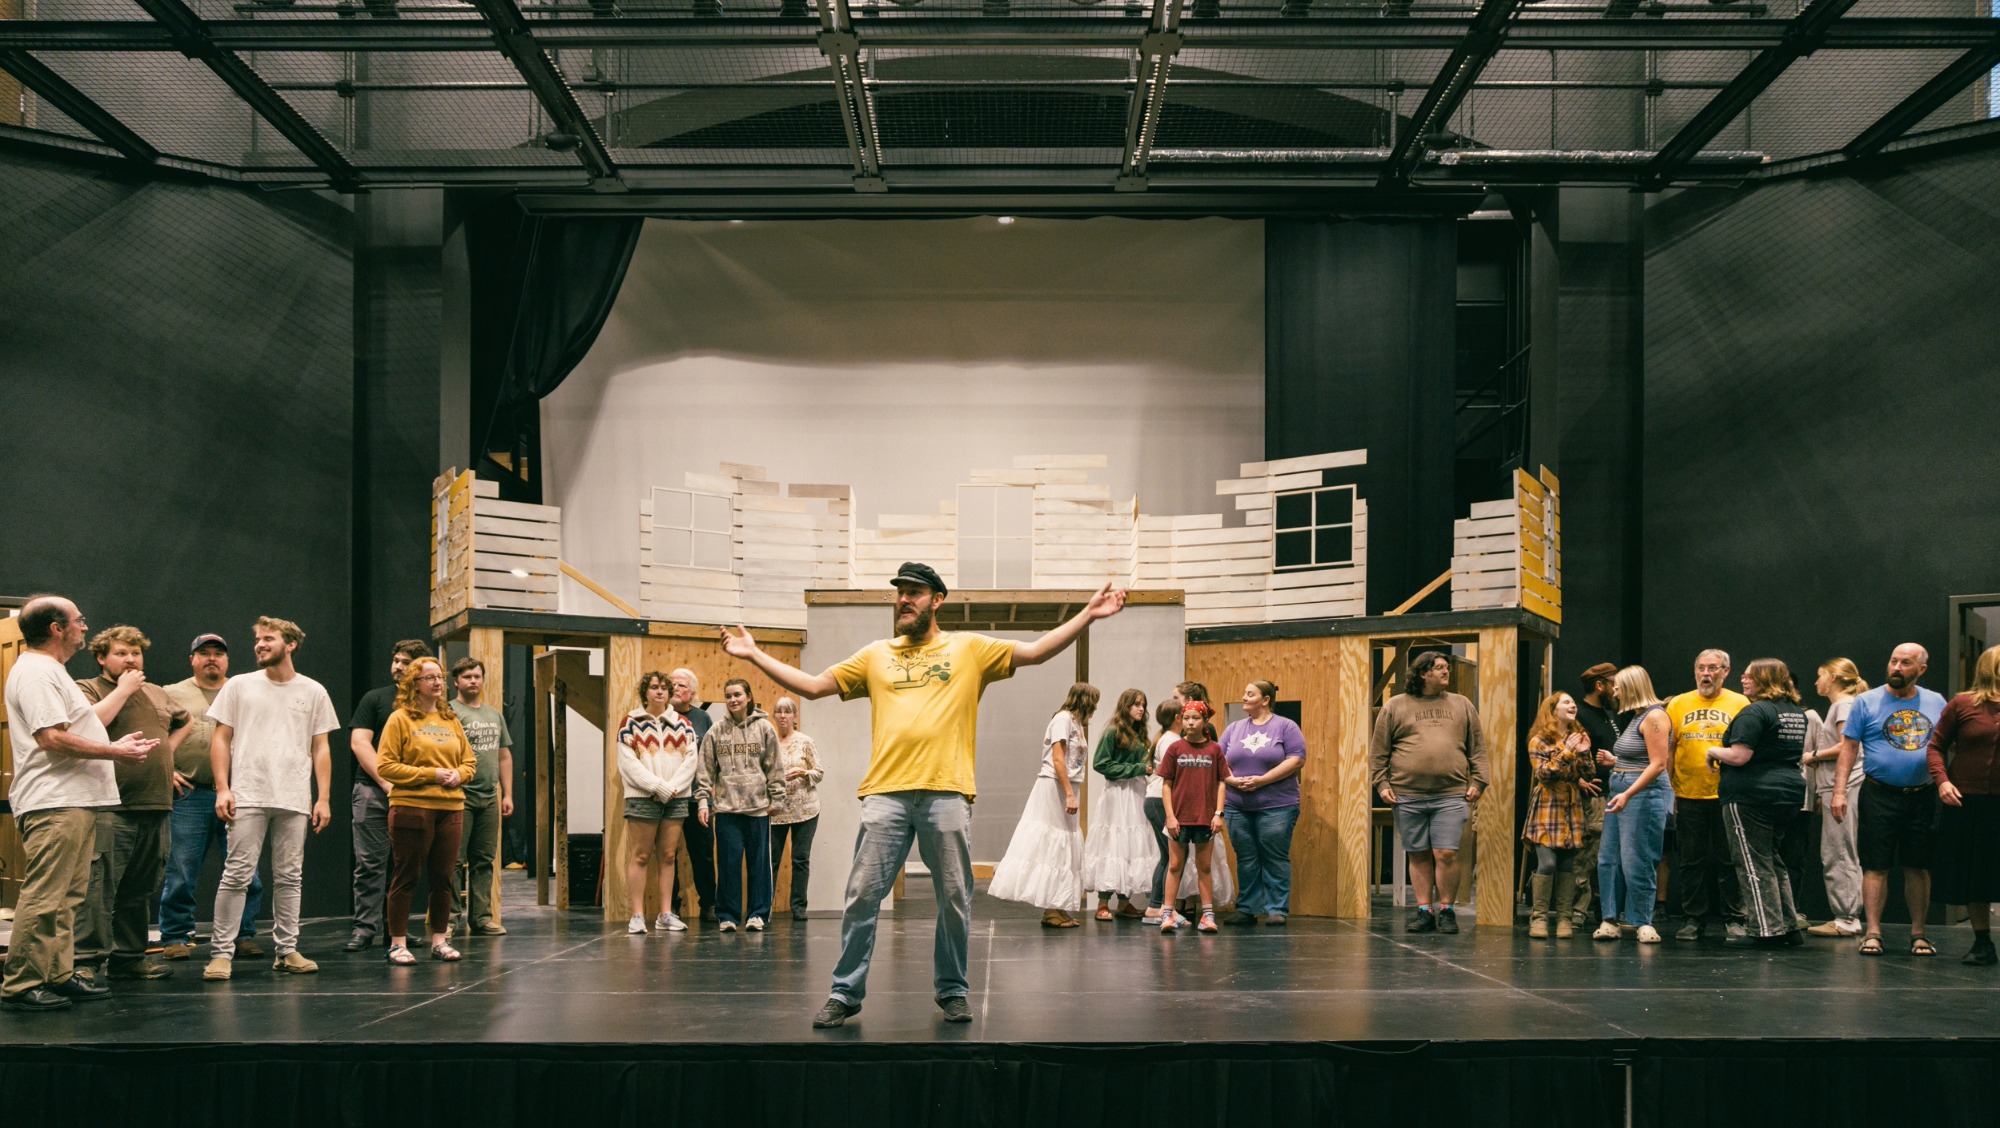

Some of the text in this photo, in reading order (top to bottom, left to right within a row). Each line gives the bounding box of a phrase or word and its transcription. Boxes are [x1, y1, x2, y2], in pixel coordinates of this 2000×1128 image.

[1415, 709, 1454, 721] BLACK HILLS
[1683, 708, 1732, 726] BHSU
